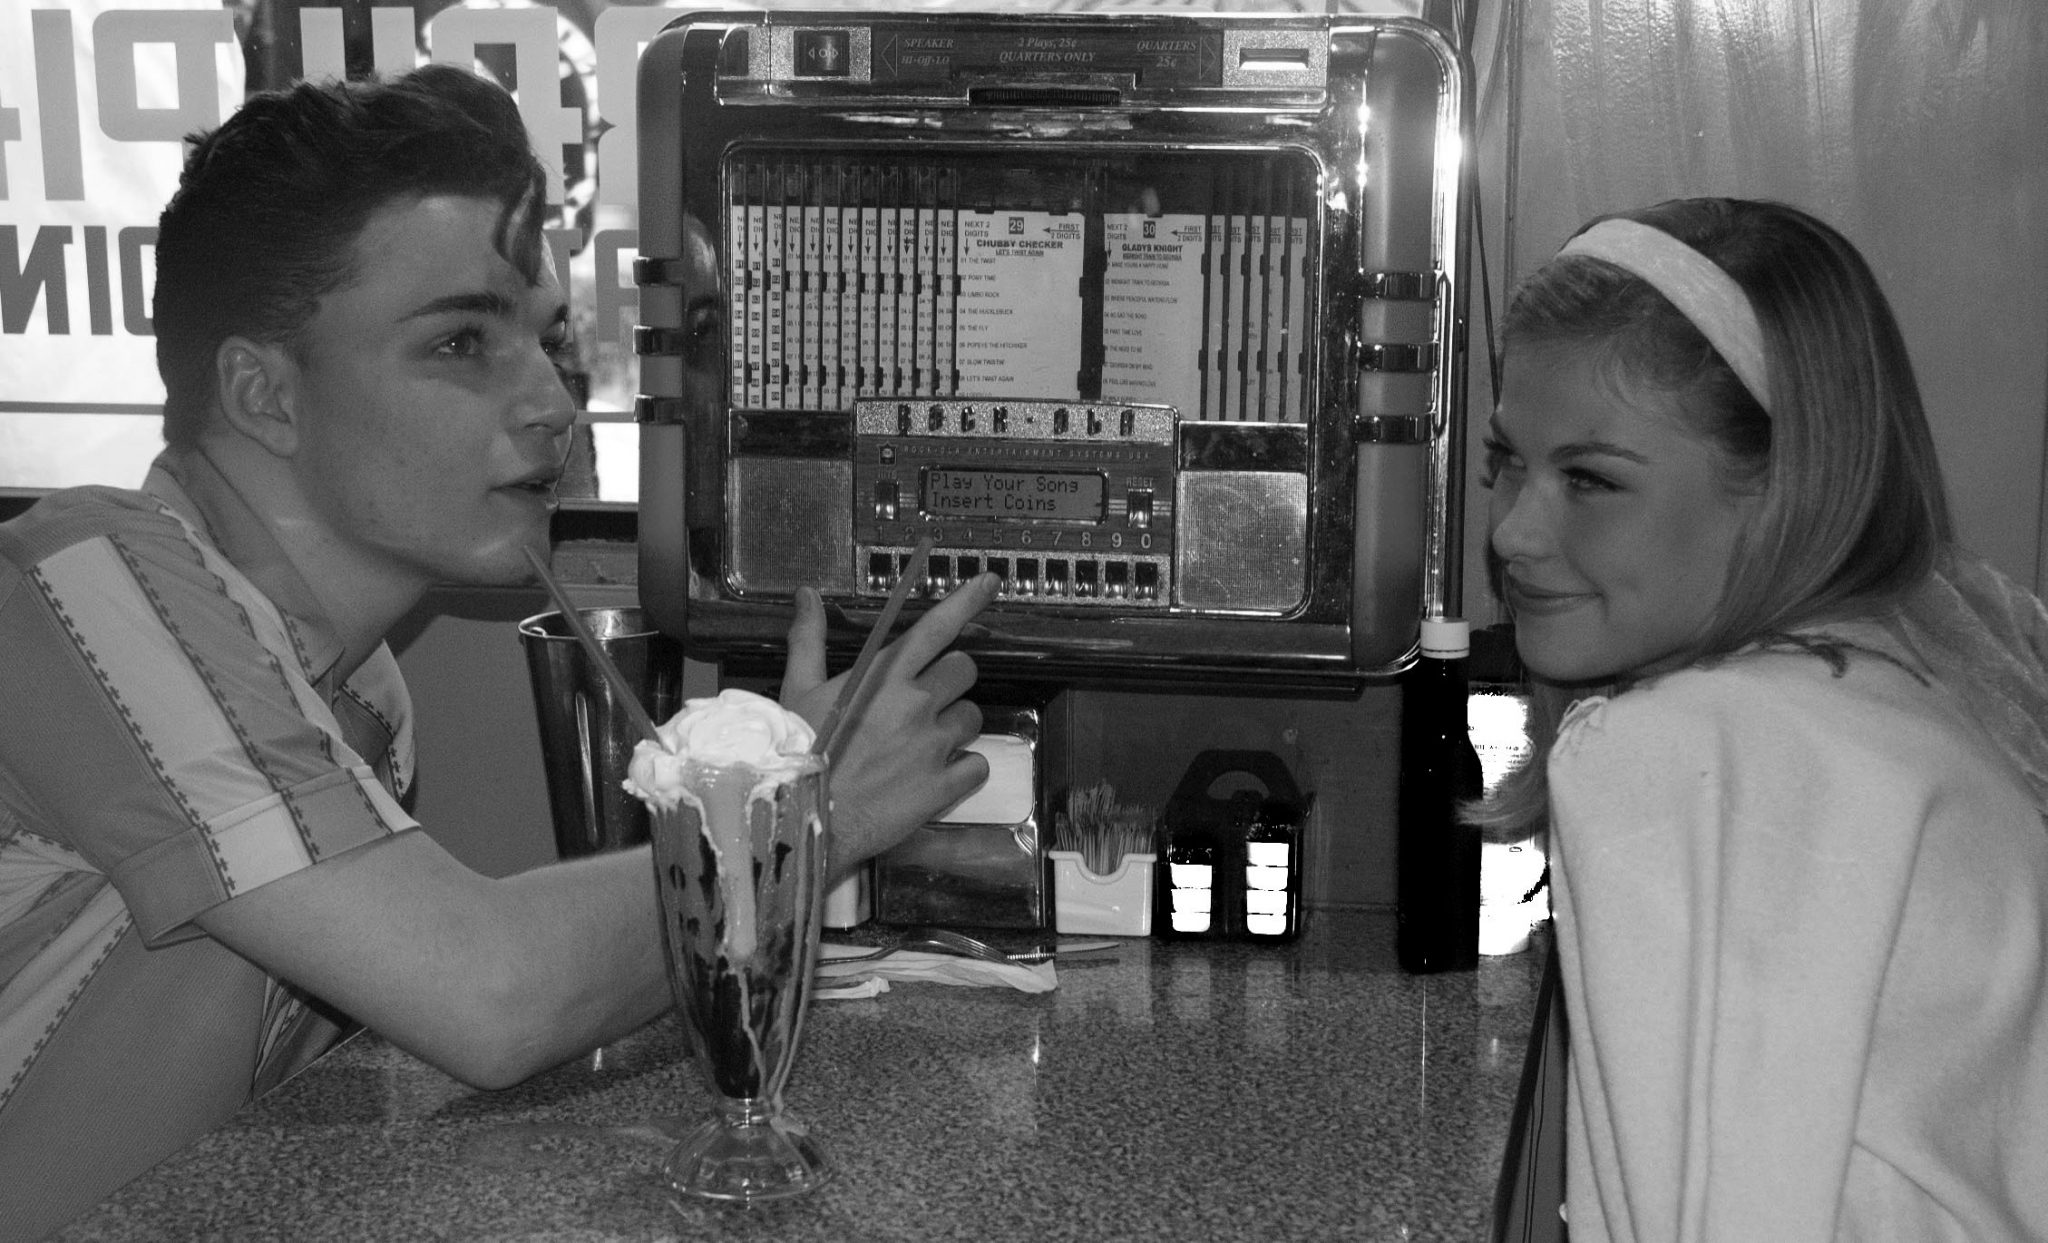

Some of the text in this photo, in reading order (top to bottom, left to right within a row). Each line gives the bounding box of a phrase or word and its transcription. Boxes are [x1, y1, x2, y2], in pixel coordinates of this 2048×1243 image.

[904, 38, 955, 49] SPEAKER
[1136, 40, 1198, 53] QUARTERS
[999, 51, 1096, 63] QUARTERS ONLY
[964, 221, 990, 229] NEXT 2
[1008, 216, 1024, 235] 29
[1058, 223, 1080, 231] FIRST
[1143, 221, 1156, 238] 30
[964, 230, 989, 238] DIGITS
[1056, 232, 1081, 240] DIGITS
[1106, 233, 1127, 241] DIGITS
[976, 239, 1064, 249] CHUBBY CHECKER
[1121, 244, 1184, 253] GLADYS KNIGHT
[930, 472, 1079, 493] Play Your Song
[932, 491, 1057, 511] Insert Coins
[904, 526, 915, 541] 2
[933, 526, 944, 541] 3
[962, 527, 974, 541] 4
[992, 528, 1003, 544] 5
[1021, 529, 1032, 545] 6
[1051, 530, 1062, 546] 7
[1081, 531, 1092, 547] 8
[1111, 532, 1122, 548] 9
[1140, 533, 1152, 549] 0
